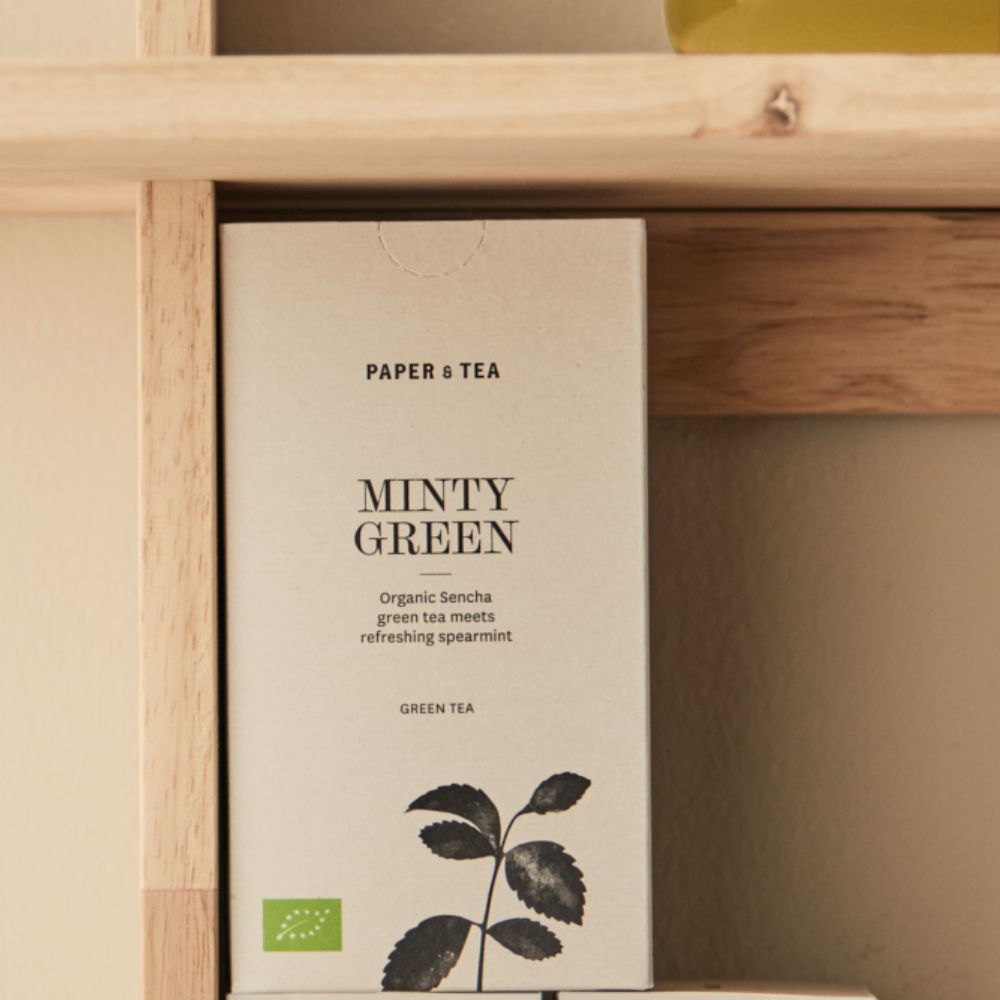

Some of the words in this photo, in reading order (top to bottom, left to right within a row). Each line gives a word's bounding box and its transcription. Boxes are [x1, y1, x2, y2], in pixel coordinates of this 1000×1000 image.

[366, 362, 435, 381] PAPER
[442, 364, 453, 380] &
[459, 362, 501, 380] TEA
[357, 477, 515, 513] MINTY
[353, 520, 519, 556] GREEN
[379, 590, 436, 607] Organic
[440, 590, 493, 604] Sencha
[377, 613, 419, 627] green
[422, 612, 446, 624] tea
[450, 611, 495, 623] meets
[360, 629, 435, 646] refreshing
[438, 629, 513, 646] spearmint
[399, 703, 446, 715] GREEN
[450, 703, 475, 715] TEA
